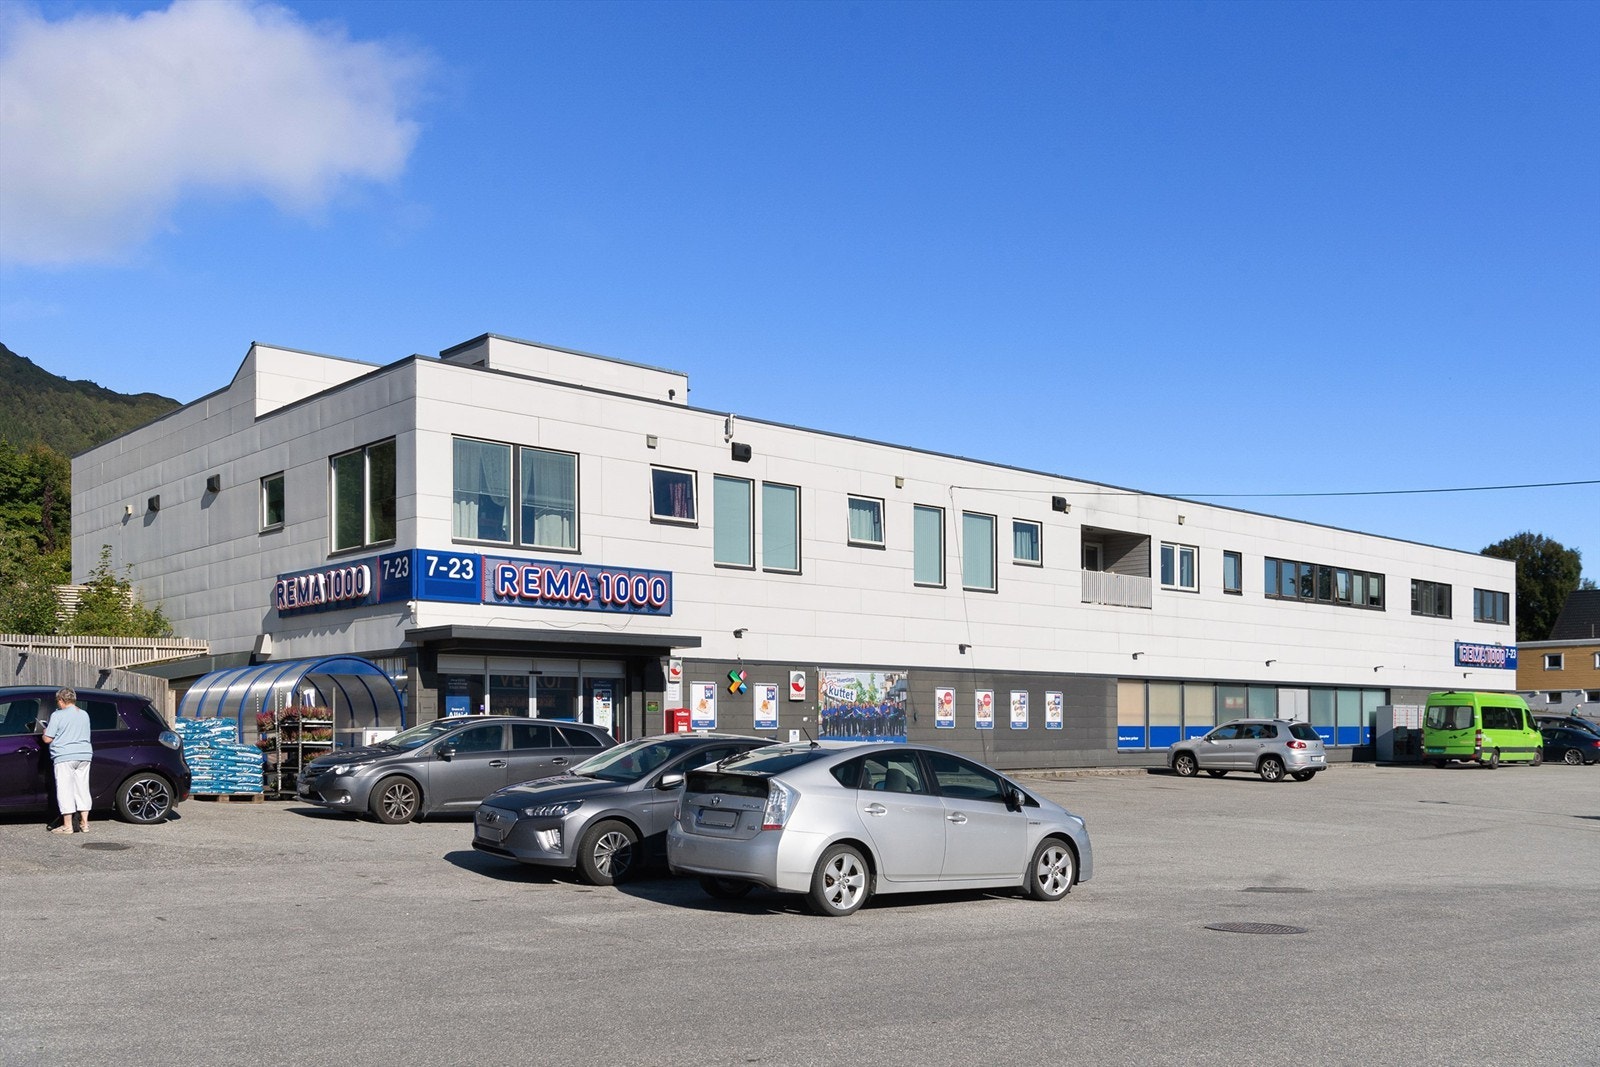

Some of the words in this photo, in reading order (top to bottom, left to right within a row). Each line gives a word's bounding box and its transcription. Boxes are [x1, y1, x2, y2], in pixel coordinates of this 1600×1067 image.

[383, 556, 409, 580] 7-23
[426, 556, 474, 580] 7-23
[275, 573, 325, 610] REMA
[325, 565, 371, 601] 1000
[495, 563, 593, 602] REMA
[598, 572, 667, 607] 1000
[1459, 645, 1486, 663] REMA
[1486, 648, 1505, 664] 1000
[1505, 648, 1516, 659] 7-23
[828, 685, 854, 701] kuttet
